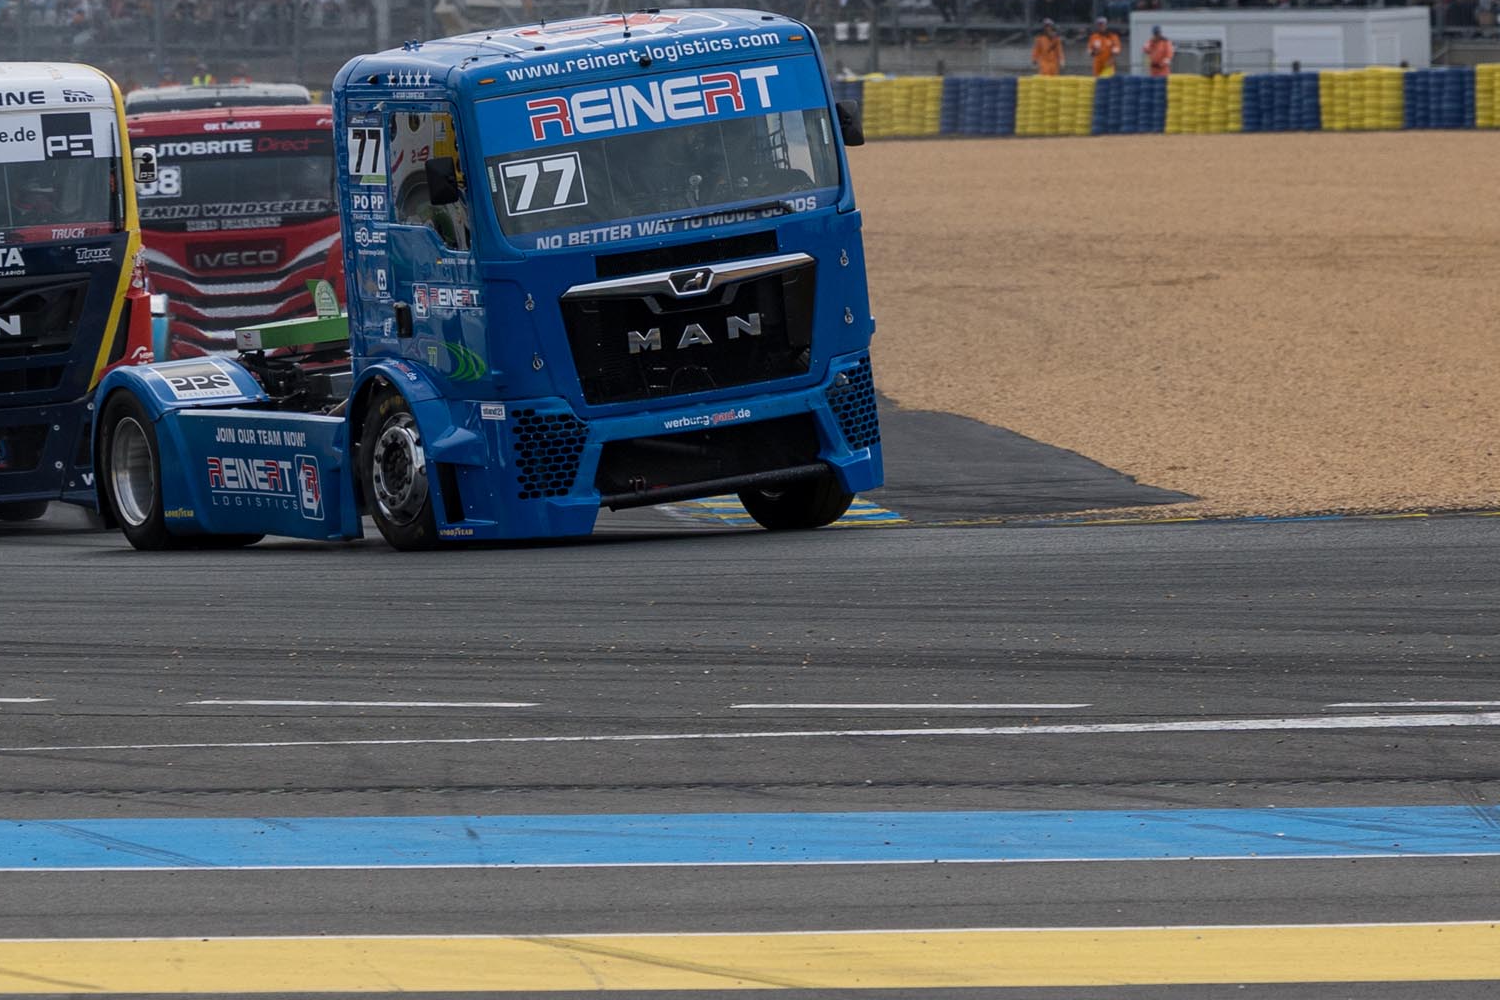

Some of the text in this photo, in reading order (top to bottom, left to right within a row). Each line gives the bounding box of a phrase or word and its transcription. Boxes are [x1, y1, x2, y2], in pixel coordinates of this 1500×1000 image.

[506, 32, 780, 82] www.reinert-logistics.com
[526, 65, 779, 141] REINERT
[46, 134, 93, 157] PE
[352, 129, 381, 173] 77
[505, 156, 577, 211] 77
[536, 235, 562, 250] NO
[568, 224, 632, 246] BETTER
[194, 250, 278, 268] IVECO
[430, 287, 480, 307] REINERT
[628, 312, 762, 354] MAN
[168, 373, 232, 392] PPS
[215, 427, 307, 448] JOIN OUR TEAM NOW!
[207, 456, 292, 493] REINERT
[212, 495, 299, 510] LOGISTICS
